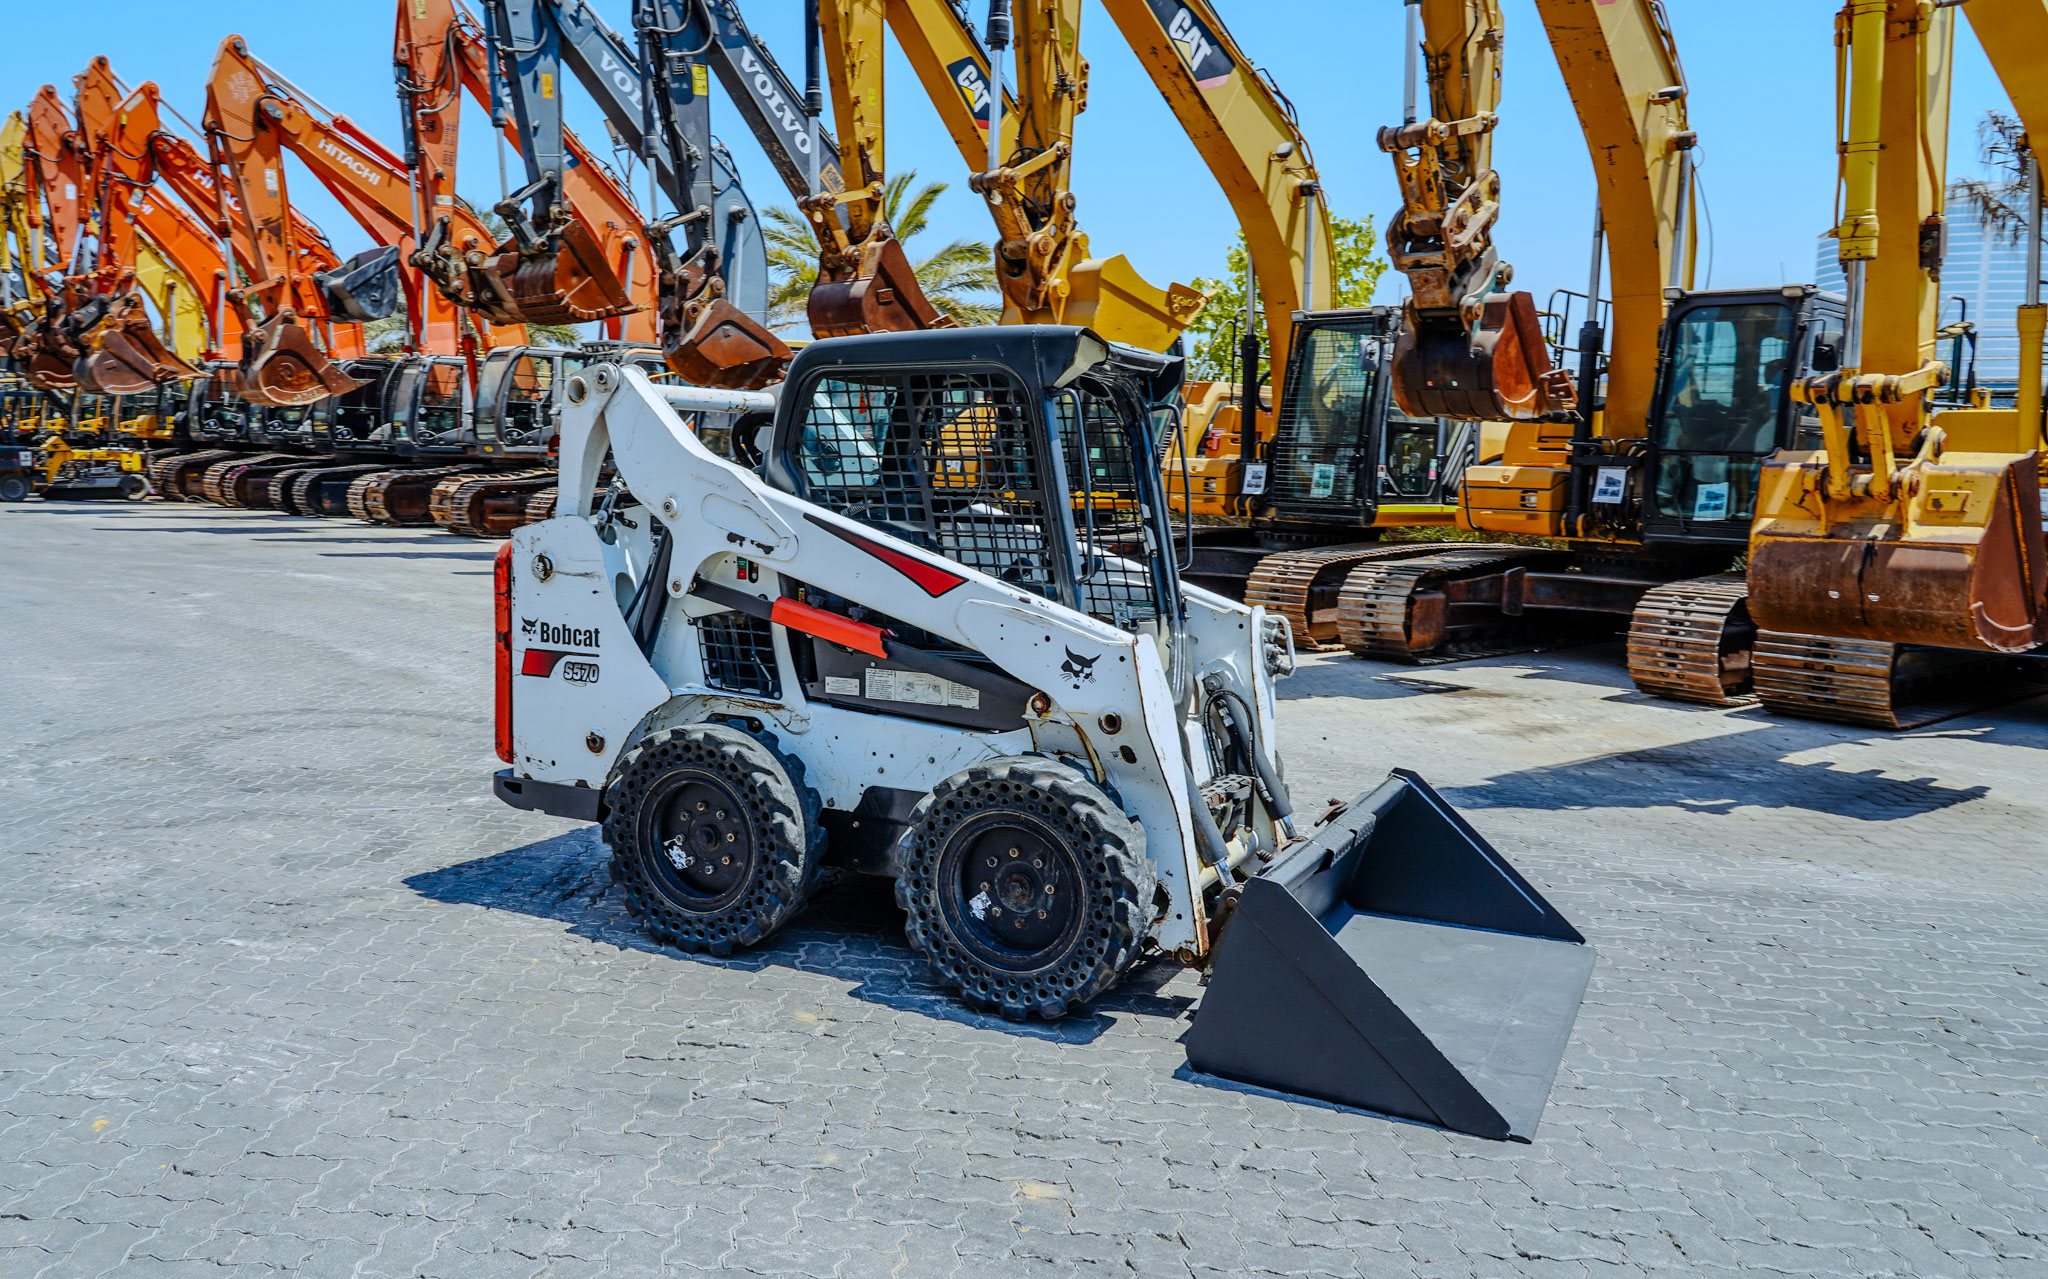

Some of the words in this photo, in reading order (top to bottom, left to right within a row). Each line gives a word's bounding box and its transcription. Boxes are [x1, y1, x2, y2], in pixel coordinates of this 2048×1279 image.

[1168, 8, 1212, 72] CAT
[740, 45, 812, 154] VOLVO
[957, 64, 992, 113] CAT
[317, 137, 381, 186] HITACHI
[540, 621, 600, 648] Bobcat
[563, 661, 600, 683] S570
